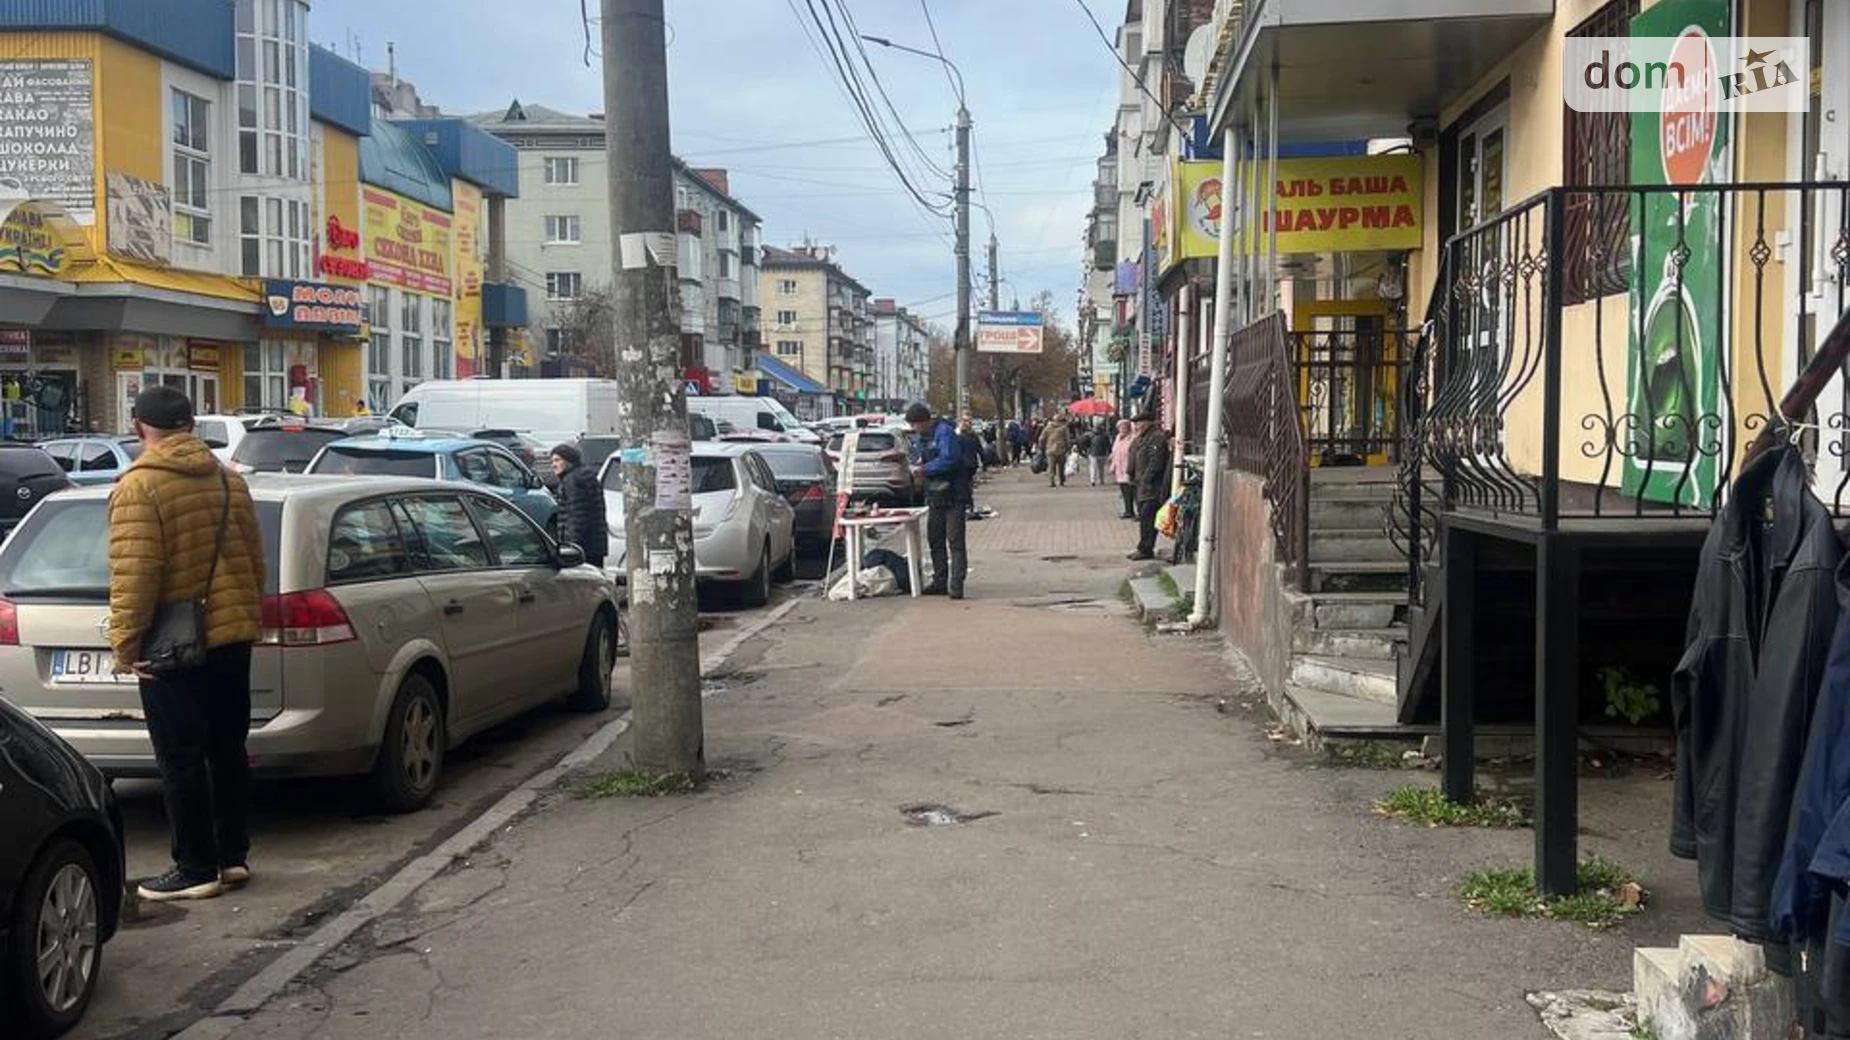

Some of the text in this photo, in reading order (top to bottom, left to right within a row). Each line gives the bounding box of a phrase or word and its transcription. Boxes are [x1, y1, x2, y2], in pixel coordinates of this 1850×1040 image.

[0, 91, 35, 104] АВА
[0, 108, 49, 121] АКАО
[0, 125, 78, 138] АПУЧИНО
[1666, 107, 1710, 158] ВСІМ!
[1329, 175, 1407, 196] БАША
[1263, 204, 1416, 233] ШАУРМА
